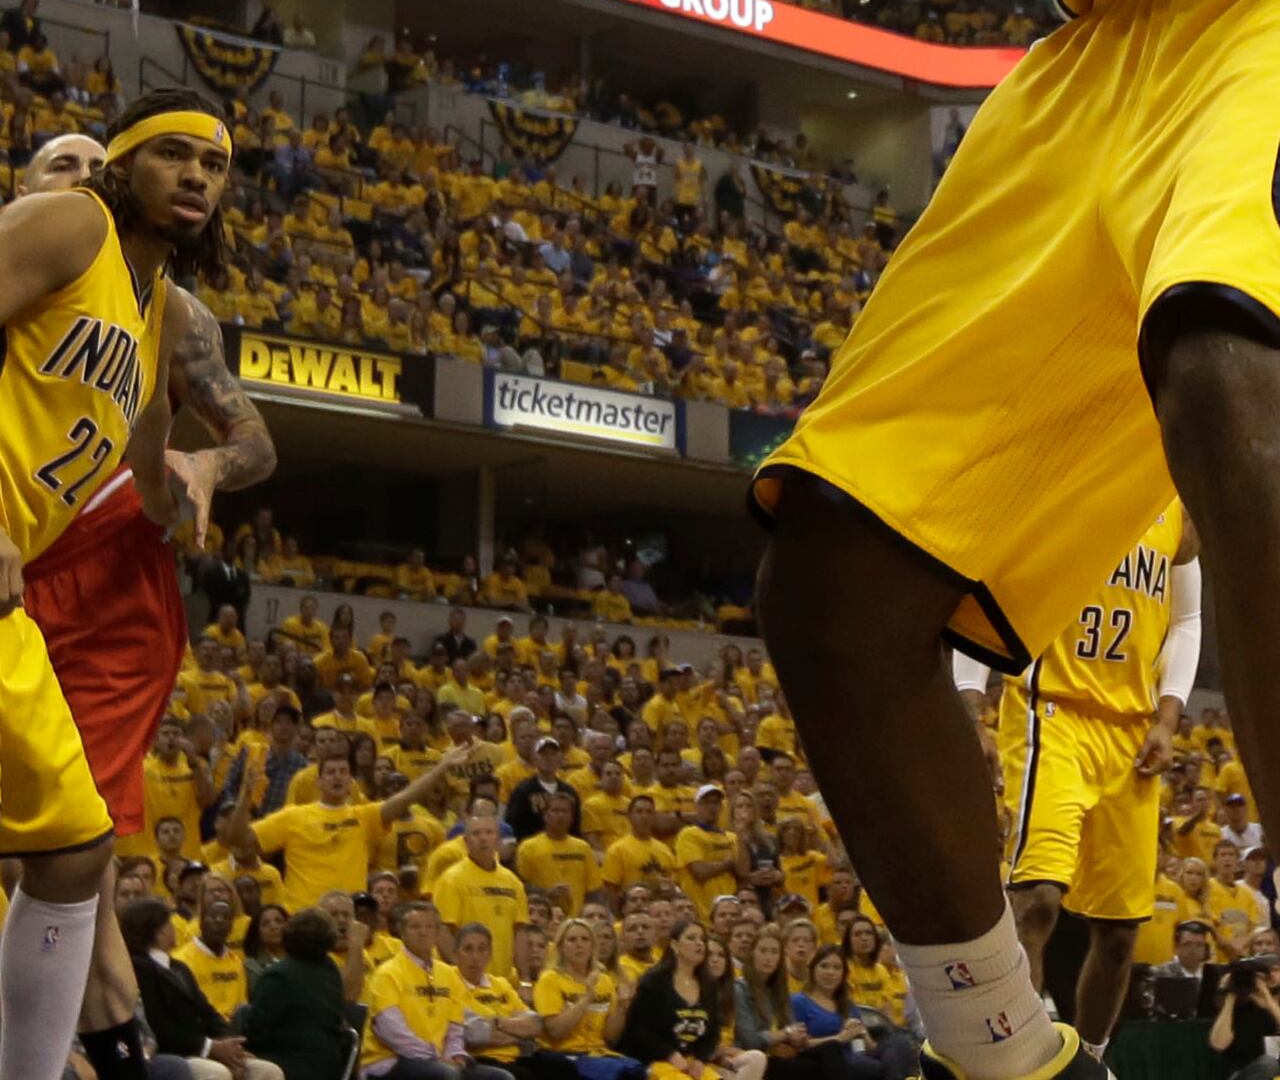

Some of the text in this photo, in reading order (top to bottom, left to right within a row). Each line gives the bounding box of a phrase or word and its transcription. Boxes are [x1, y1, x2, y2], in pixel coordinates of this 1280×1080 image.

[498, 379, 673, 435] ticketmaster
[34, 416, 117, 508] 22
[1076, 606, 1133, 662] 32
